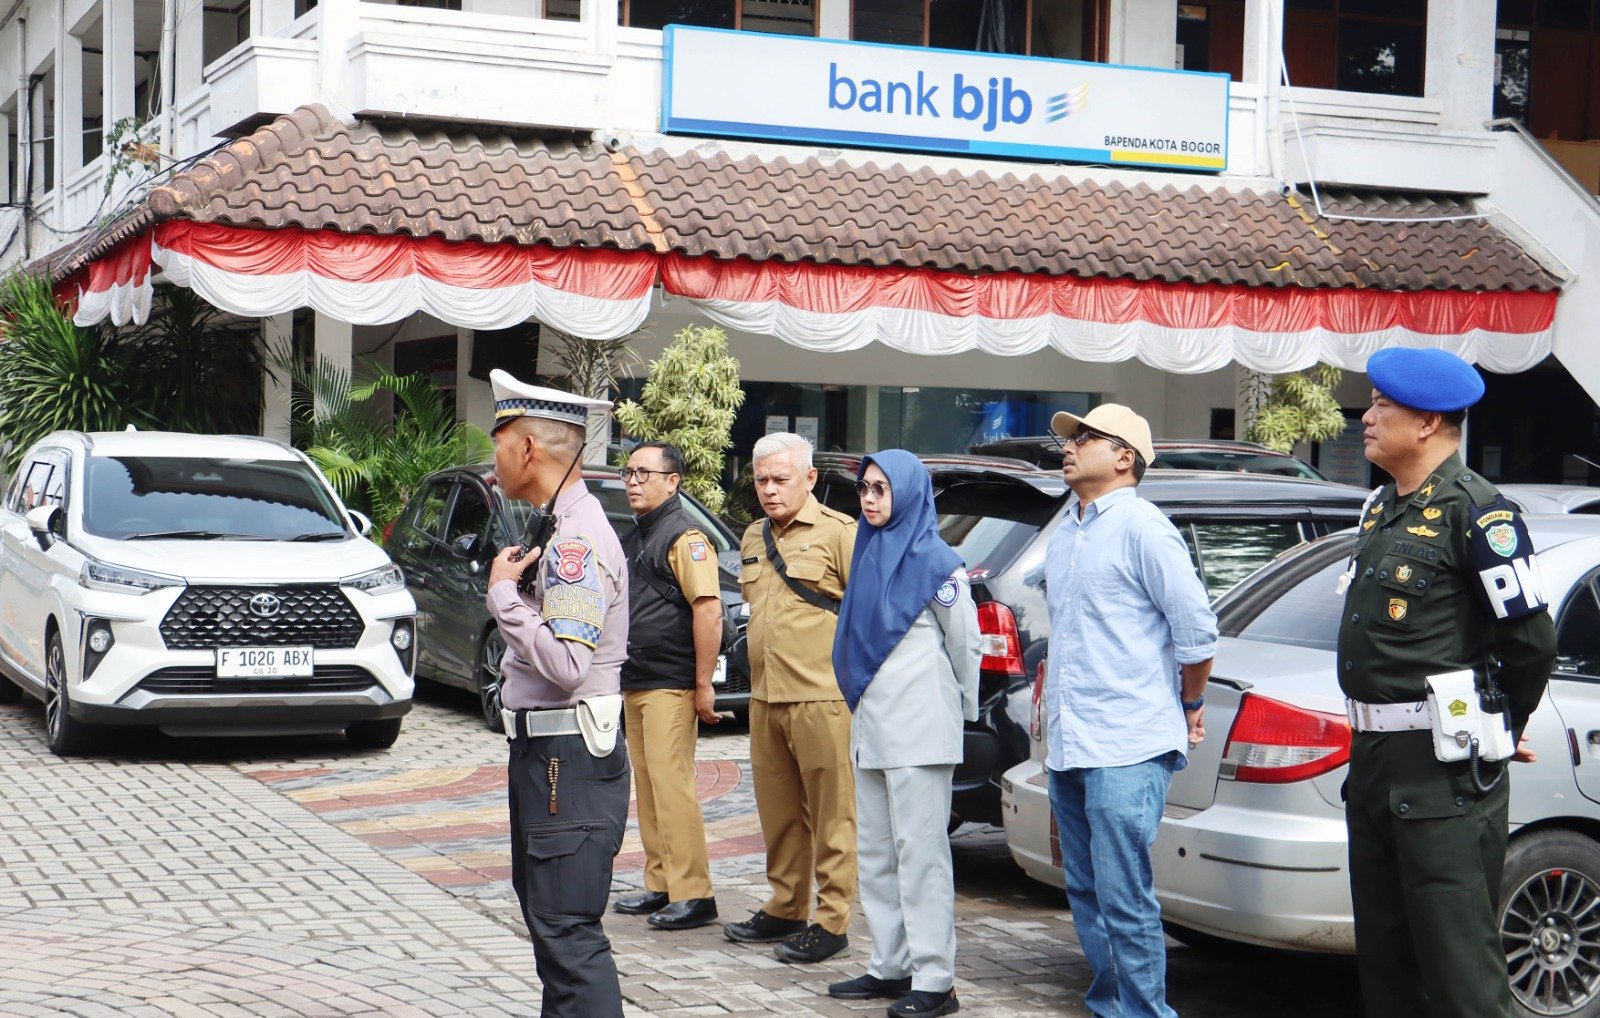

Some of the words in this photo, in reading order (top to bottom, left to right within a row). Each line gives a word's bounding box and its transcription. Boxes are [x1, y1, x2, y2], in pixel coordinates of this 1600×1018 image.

[828, 63, 940, 118] bank
[952, 73, 1033, 132] bjb
[1104, 134, 1147, 150] BAPENDA
[1149, 137, 1178, 151] KOTA
[1180, 139, 1221, 154] BOGOR
[1479, 554, 1546, 619] PM
[222, 652, 230, 667] F
[239, 651, 275, 667] 1020
[283, 650, 310, 666] ABX
